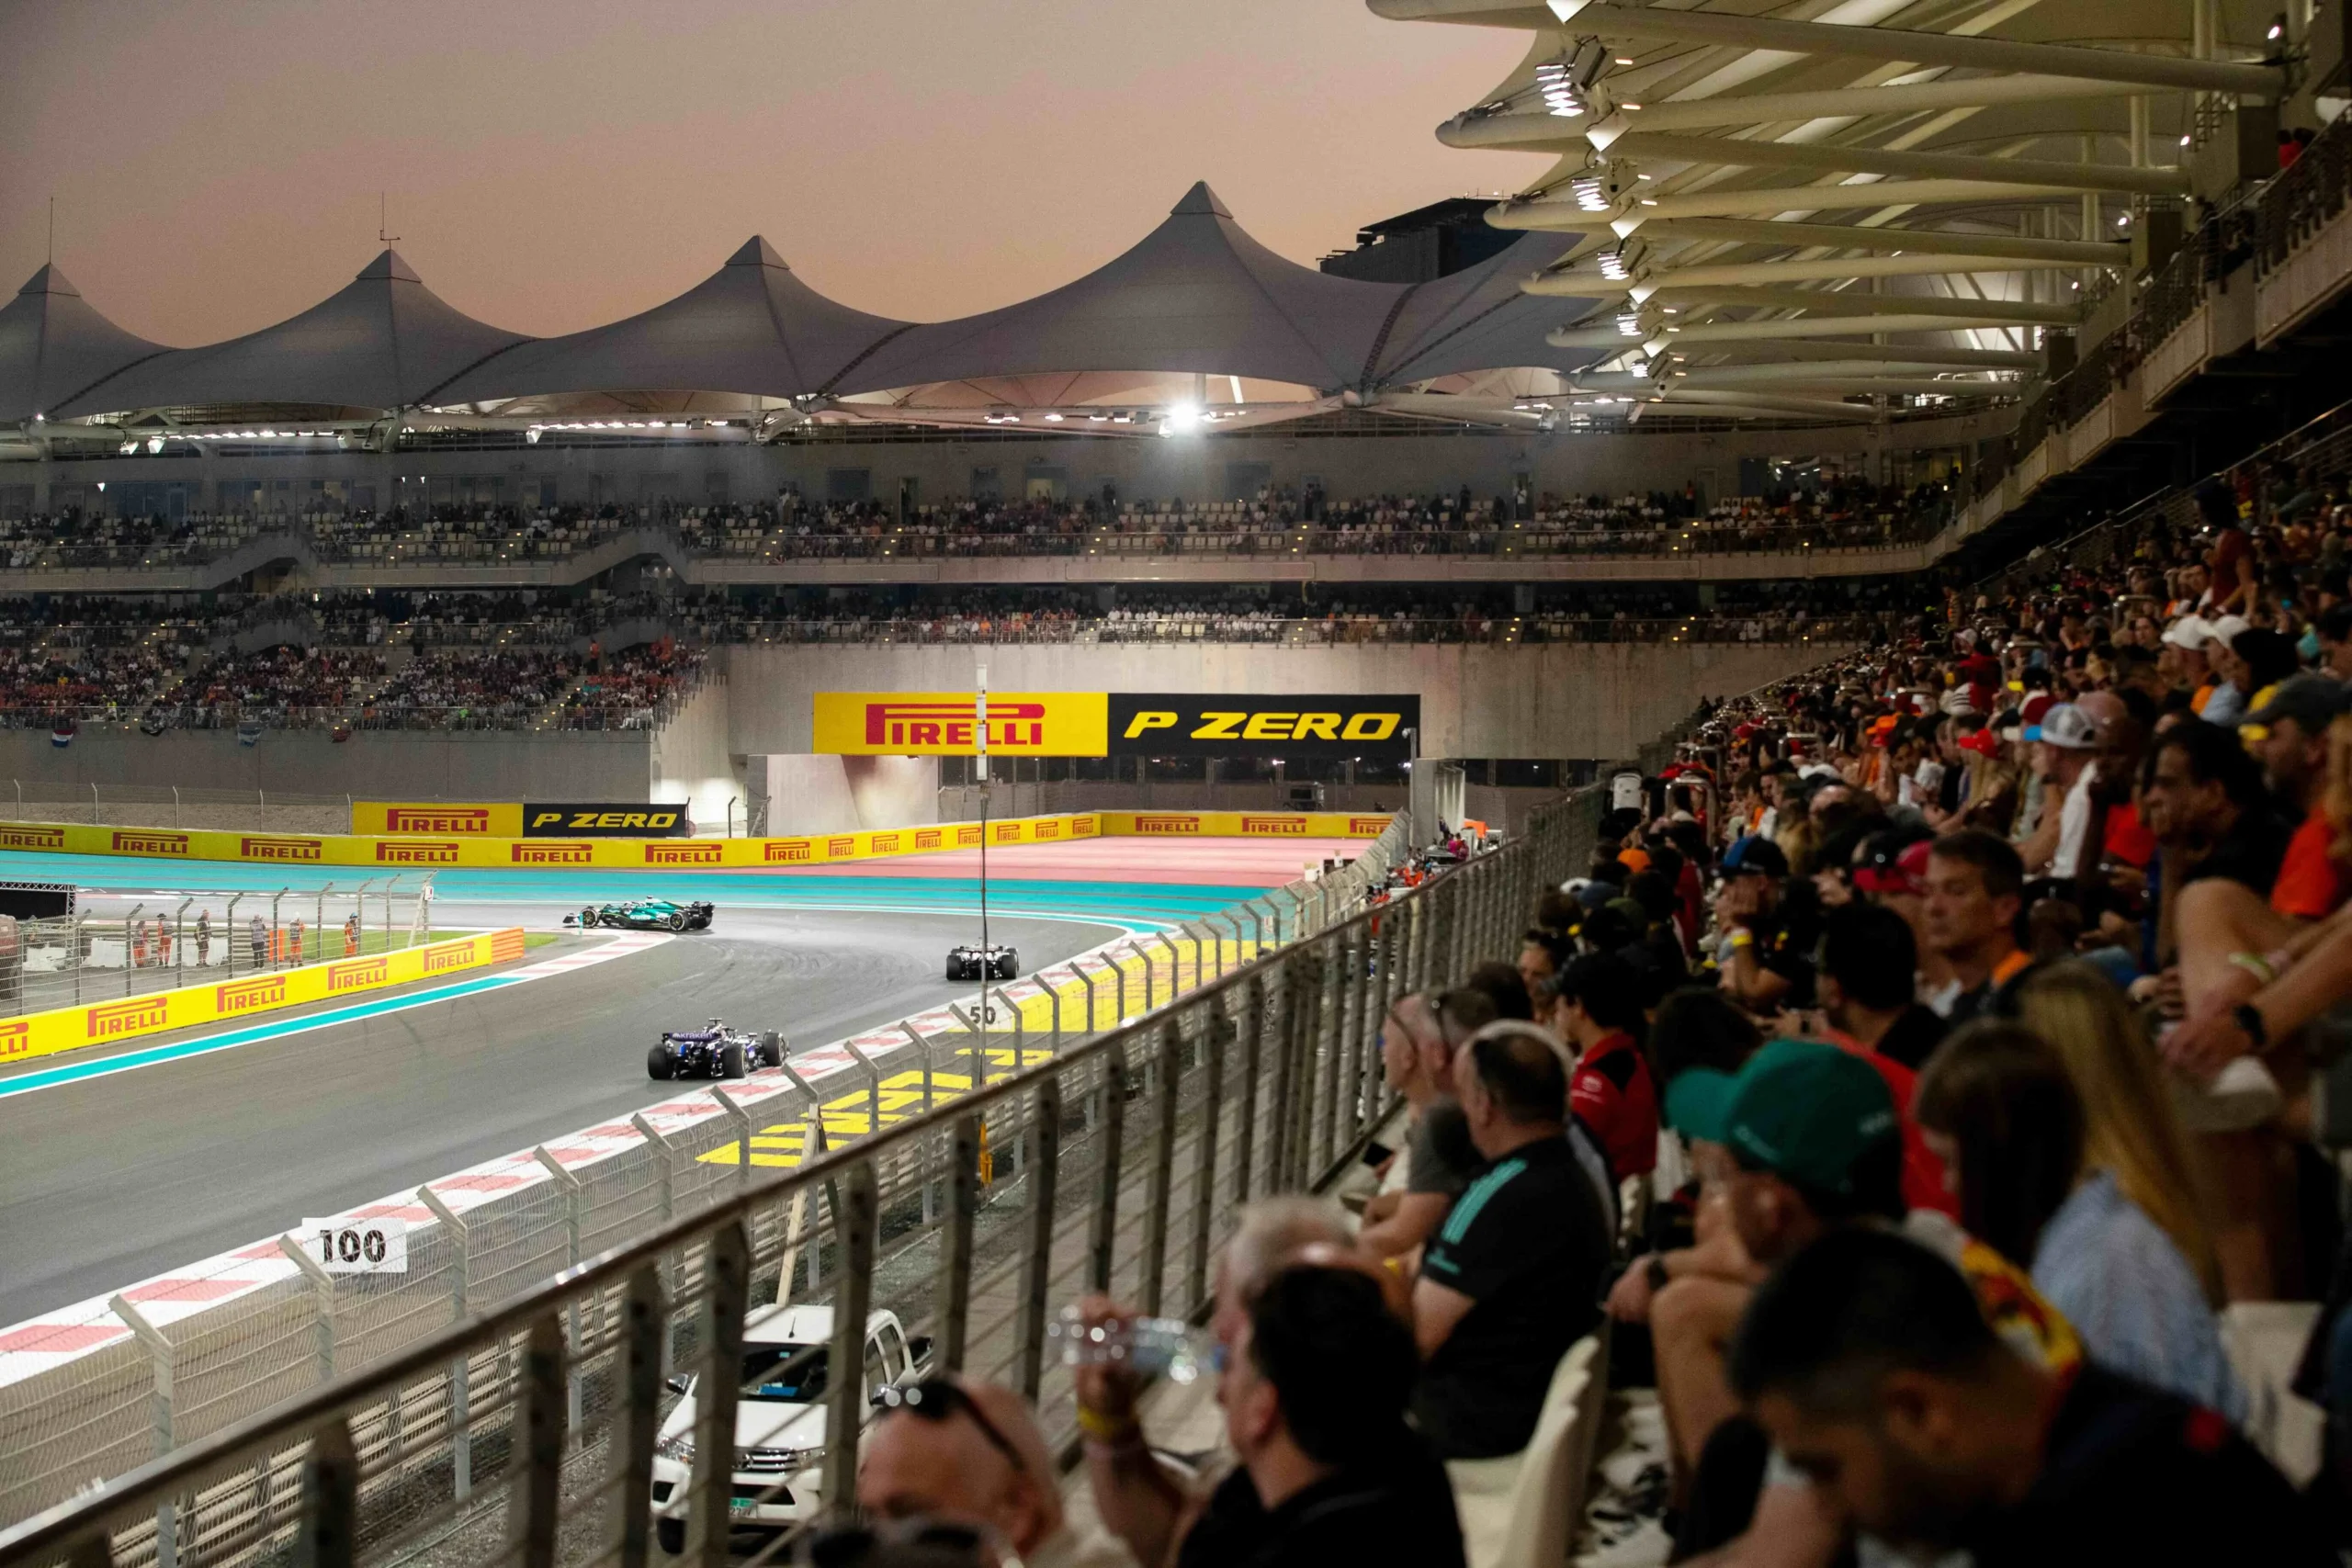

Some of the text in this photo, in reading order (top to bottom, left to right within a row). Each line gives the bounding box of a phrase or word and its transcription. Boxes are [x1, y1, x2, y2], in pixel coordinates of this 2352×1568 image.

[865, 704, 1046, 745] PIRELLI
[1124, 712, 1401, 739] P ZERO
[387, 808, 489, 831] PIRELLI
[532, 813, 678, 828] P ZERO
[1072, 818, 1093, 834] PIRELLI
[1136, 817, 1199, 832] PIRELLI
[1242, 818, 1306, 833] PIRELLI
[958, 828, 981, 844] PIRELLI
[997, 824, 1020, 841] PIRELLI
[1035, 821, 1058, 838] PIRELLI
[112, 832, 188, 853] PIRELLI
[242, 838, 322, 859] PIRELLI
[829, 838, 854, 856] PIRELLI
[872, 834, 899, 852] PIRELLI
[915, 830, 942, 849] PIRELLI
[377, 842, 458, 862] PIRELLI
[512, 844, 593, 862] PIRELLI
[645, 844, 722, 863] PIRELLI
[764, 841, 810, 861] PIRELLI
[424, 941, 474, 972] PIRELLI
[328, 958, 387, 990] PIRELLI
[217, 976, 286, 1012] PIRELLI
[87, 998, 167, 1037] PIRELLI
[970, 1006, 996, 1024] 50
[320, 1229, 386, 1263] 100
